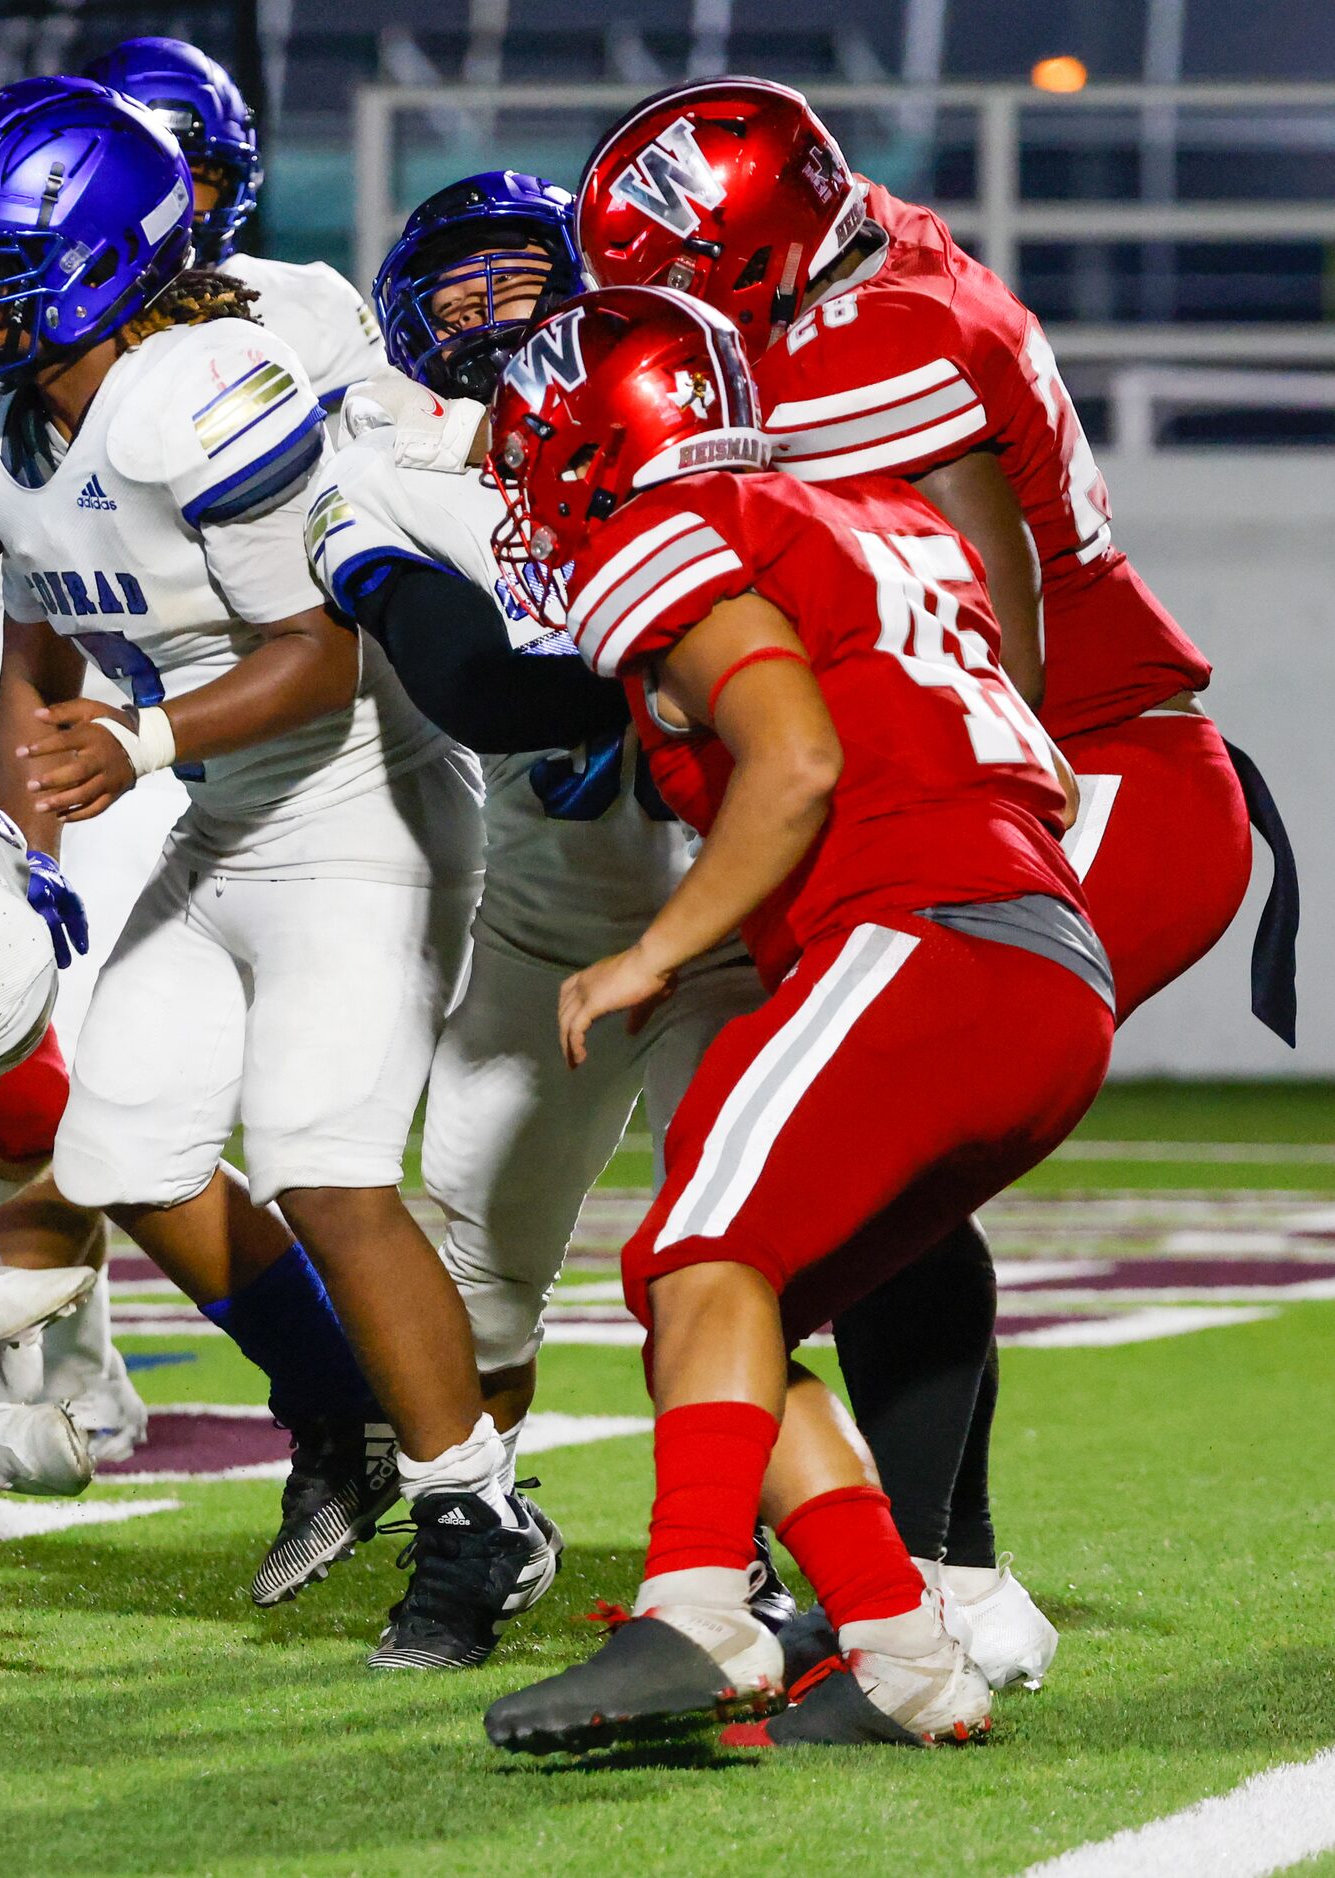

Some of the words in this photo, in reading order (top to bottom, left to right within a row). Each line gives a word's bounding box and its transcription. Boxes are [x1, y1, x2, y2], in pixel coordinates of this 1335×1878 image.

[609, 116, 727, 239] W
[786, 293, 859, 357] 28
[504, 306, 587, 414] W
[76, 496, 118, 511] adidas
[436, 1515, 471, 1527] adidas
